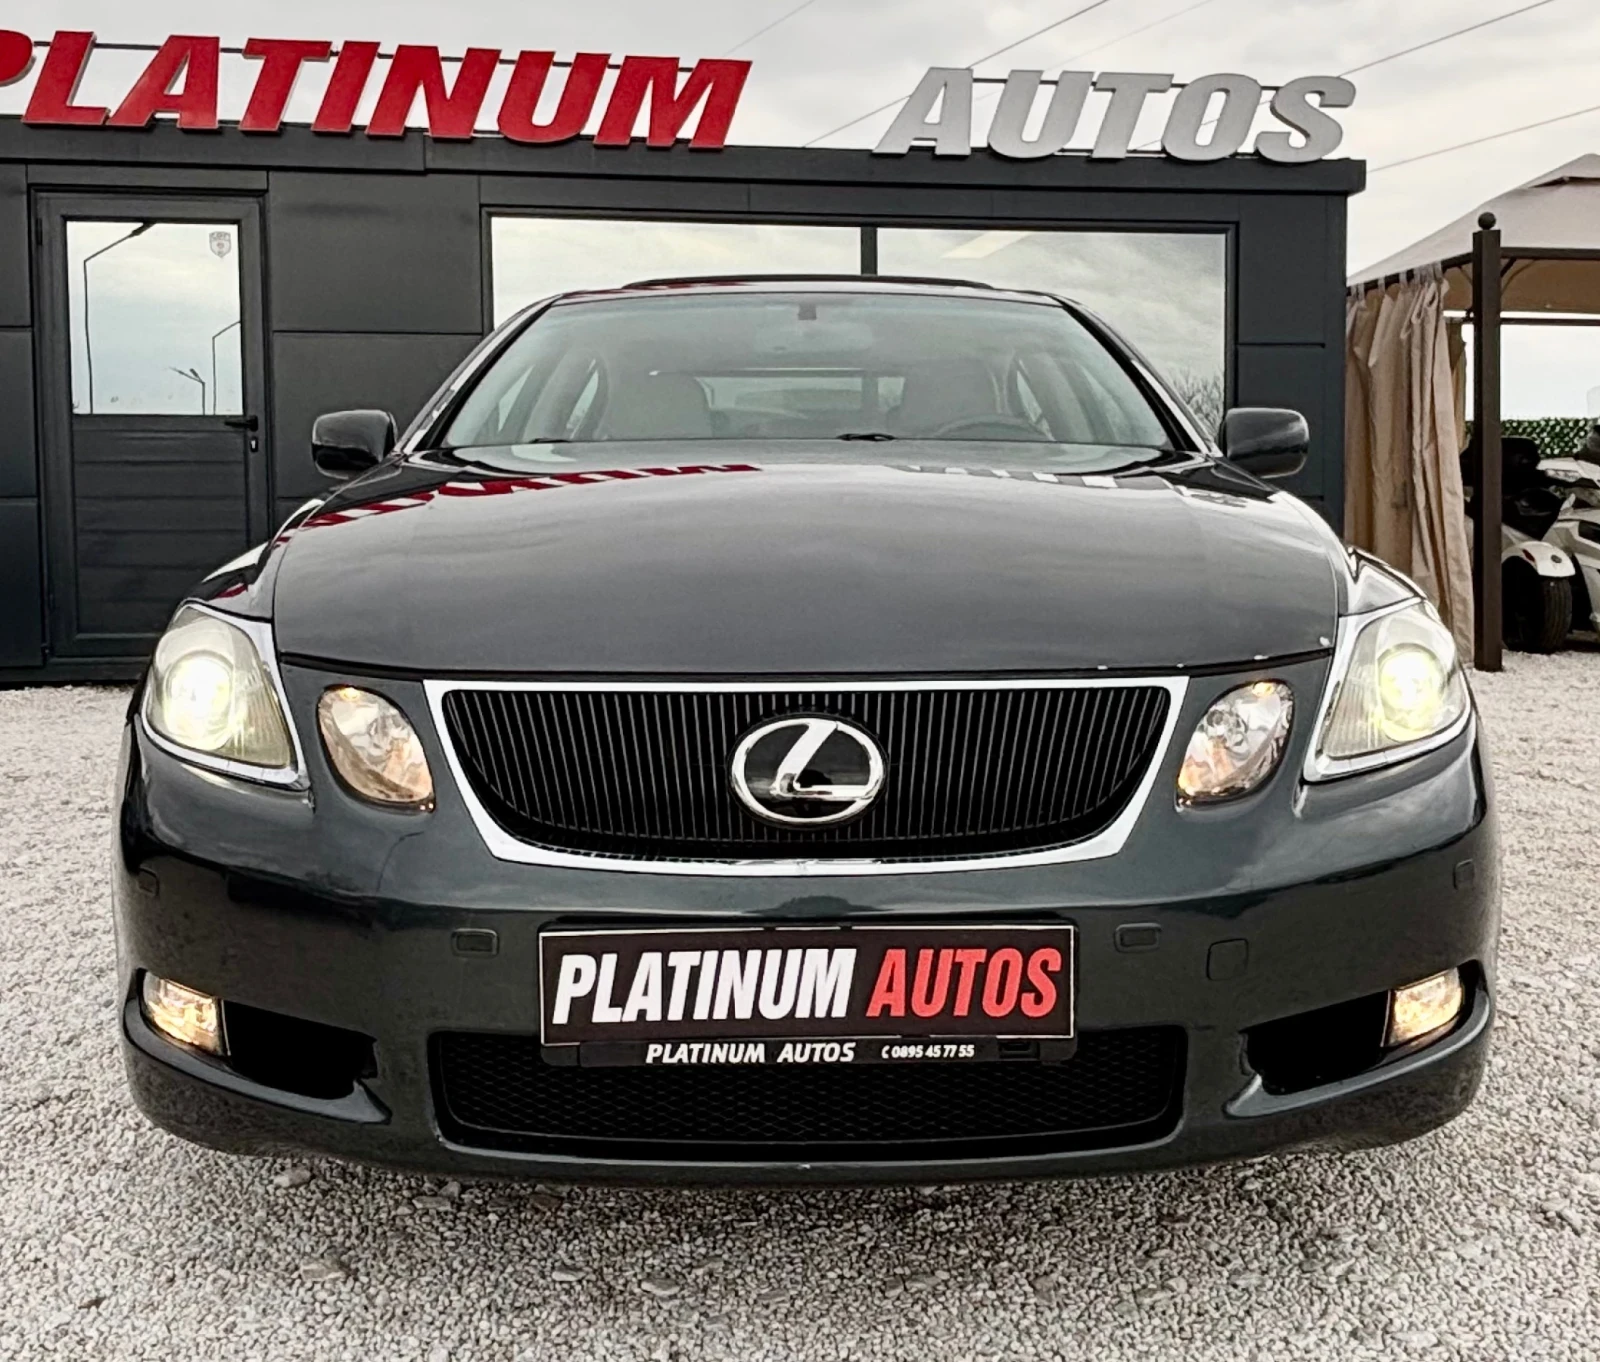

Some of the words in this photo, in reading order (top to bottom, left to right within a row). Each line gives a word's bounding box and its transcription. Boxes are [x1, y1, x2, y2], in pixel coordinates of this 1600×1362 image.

[872, 66, 1357, 163] AUTOS
[552, 948, 857, 1024] PLATINUM
[866, 947, 1063, 1019] AUTOS
[645, 1042, 766, 1064] PLATINUM
[776, 1041, 856, 1063] AUTOS
[891, 1045, 924, 1058] 0895
[924, 1045, 942, 1058] 45
[943, 1044, 958, 1058] 77
[958, 1044, 975, 1058] 55
